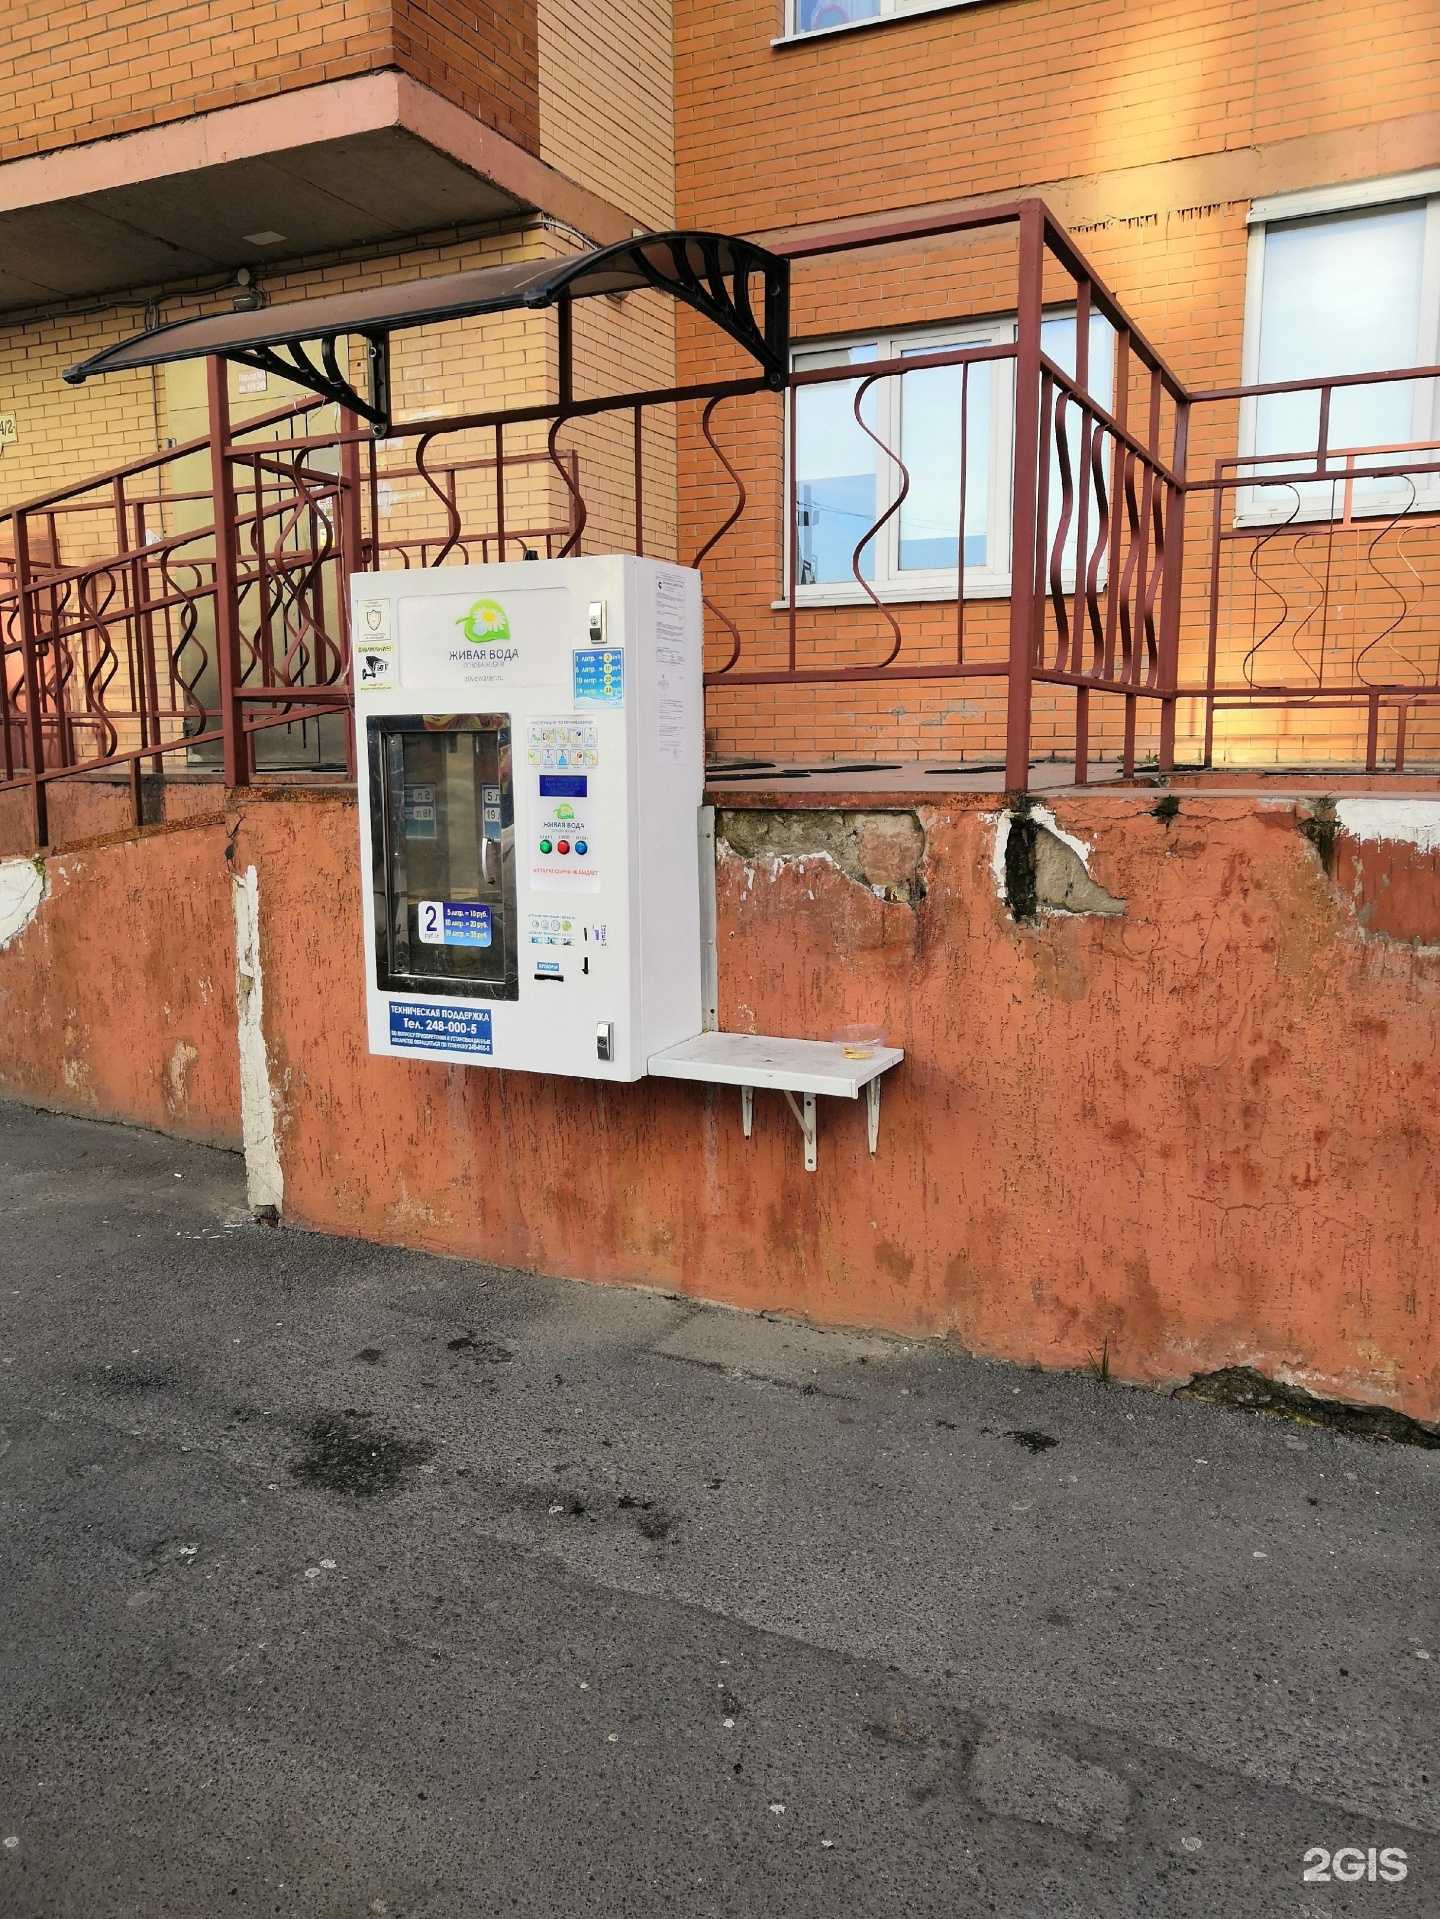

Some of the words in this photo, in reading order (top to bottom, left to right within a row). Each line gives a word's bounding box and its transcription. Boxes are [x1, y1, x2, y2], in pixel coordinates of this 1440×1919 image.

[449, 650, 486, 660] ЖИВАЯ
[489, 648, 519, 661] ВОДА
[567, 822, 584, 830] ВОДА
[426, 906, 438, 932] 2
[477, 910, 488, 918] руб.
[391, 1005, 440, 1018] ТЕХНИЧЕСКАЯ
[442, 1009, 490, 1022] ПОДДЕРЖКА
[403, 1018, 424, 1030] Тел.
[426, 1020, 477, 1034] 248-000-5
